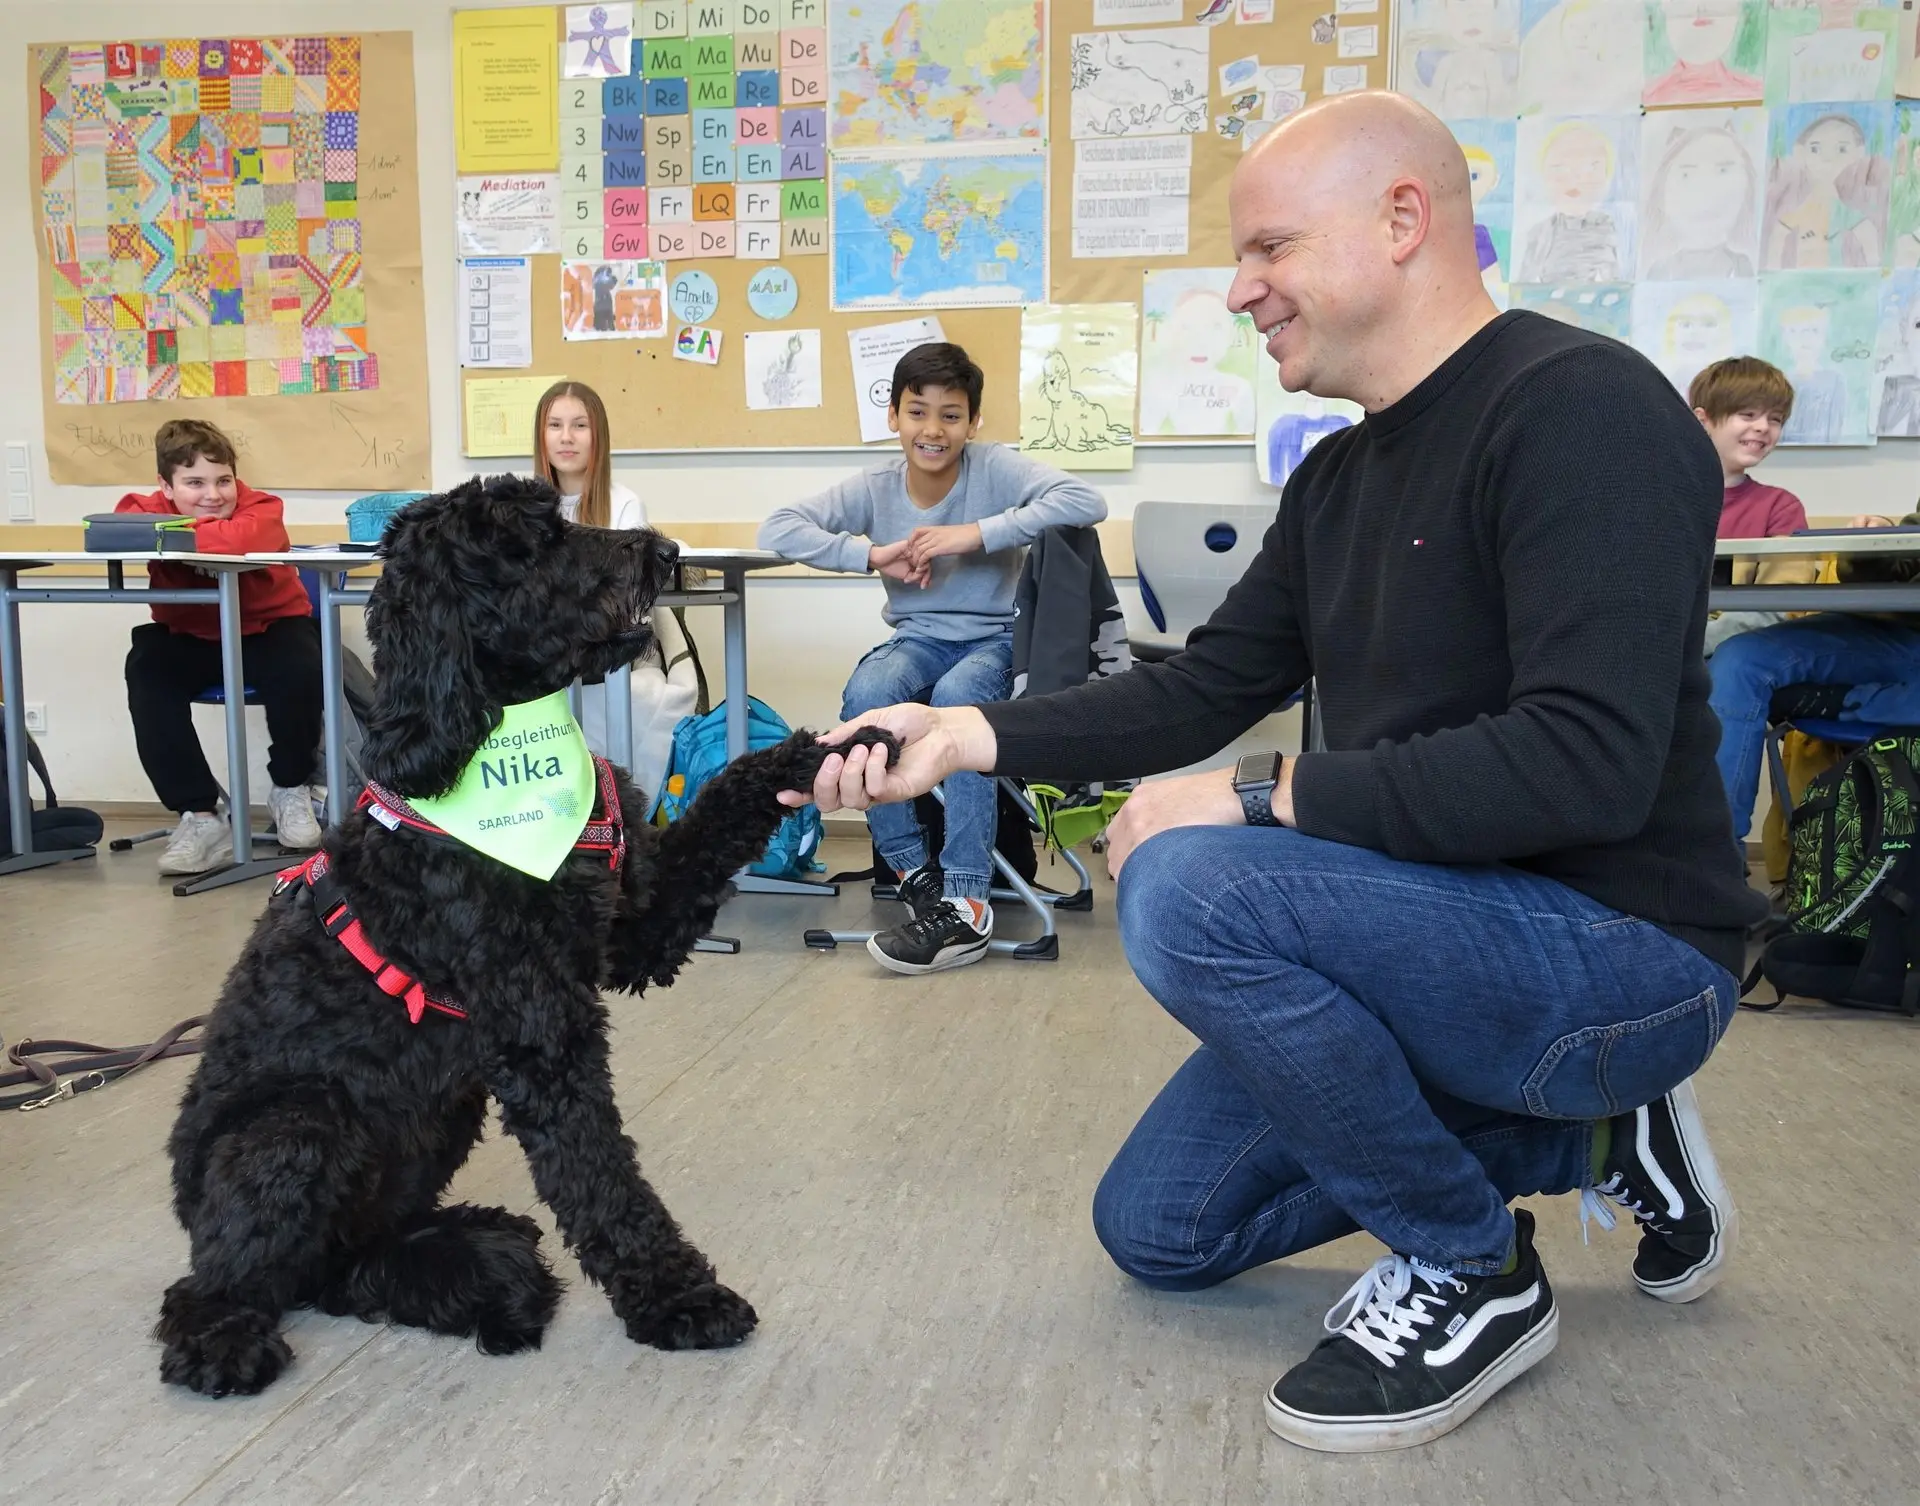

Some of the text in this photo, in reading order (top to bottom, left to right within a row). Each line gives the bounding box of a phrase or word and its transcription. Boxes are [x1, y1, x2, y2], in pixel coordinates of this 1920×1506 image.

[655, 11, 676, 30] Di
[698, 7, 724, 28] Mi
[743, 4, 770, 25] Do
[791, 0, 815, 20] Fr
[651, 50, 682, 71] Ma
[697, 46, 727, 66] Ma
[741, 43, 772, 63] Mu
[790, 39, 818, 59] De
[574, 77, 819, 108] 2 Bk Re Ma Re De
[574, 118, 818, 149] 3 Nw Sp En De AL
[574, 152, 817, 185] 4 Nw Sp En En AL
[480, 178, 546, 192] Mediation
[576, 191, 820, 220] 5 Gw Fr LQ Fr Ma
[576, 227, 820, 256] 6 Gw De De Fr Mu
[678, 327, 715, 360] 6A
[480, 753, 563, 789] Nika
[478, 809, 544, 830] SAARLAND
[1417, 1259, 1446, 1274] VANS
